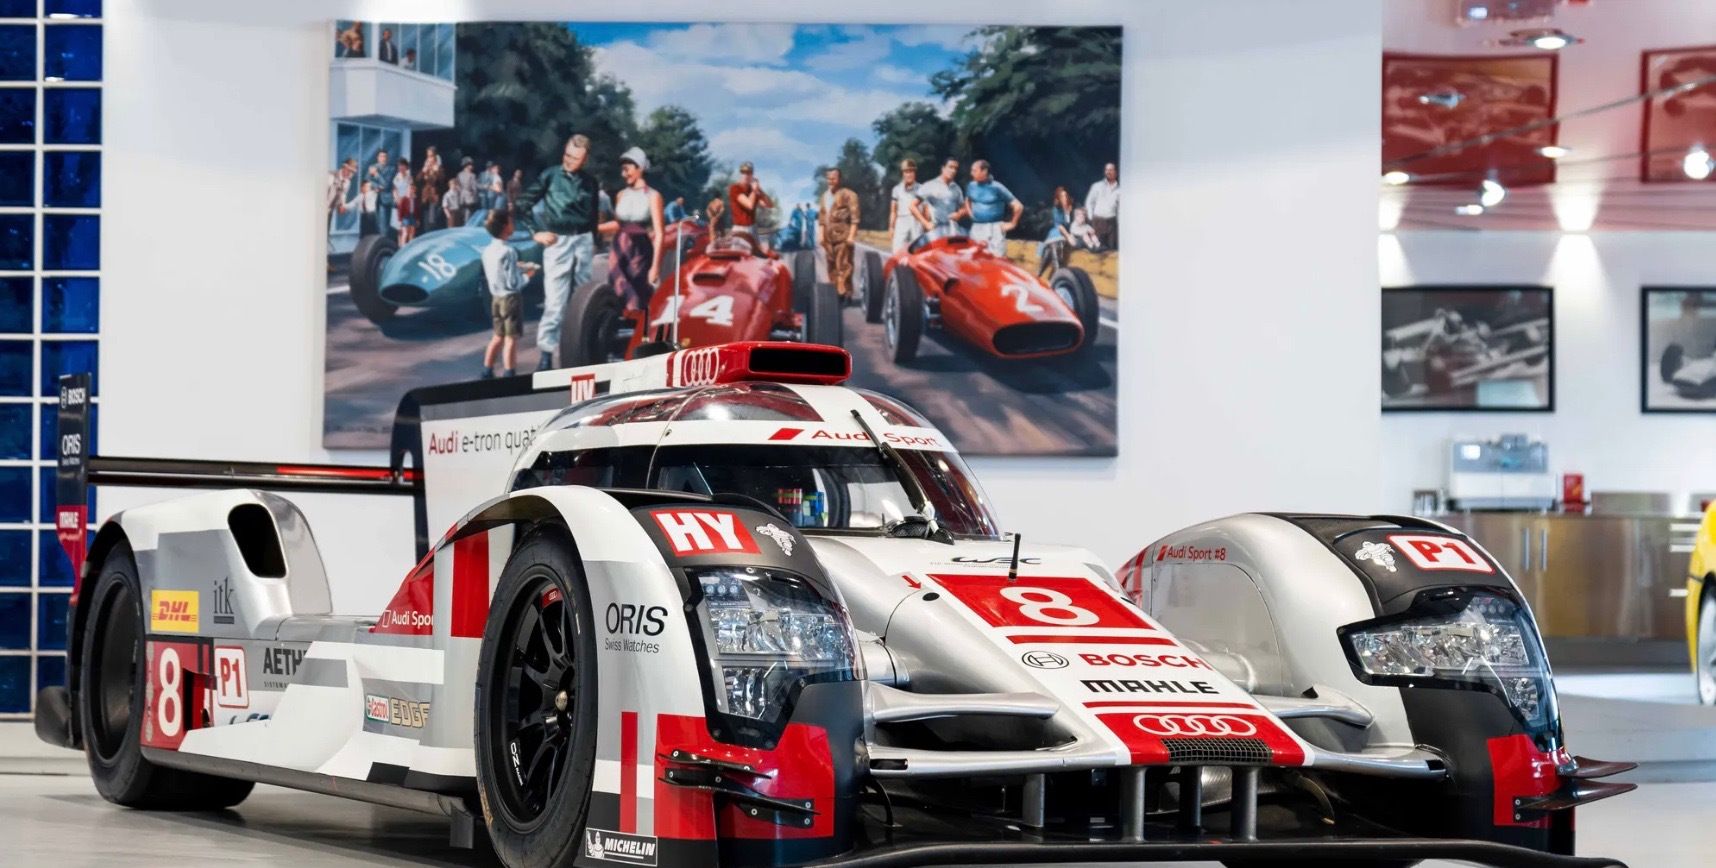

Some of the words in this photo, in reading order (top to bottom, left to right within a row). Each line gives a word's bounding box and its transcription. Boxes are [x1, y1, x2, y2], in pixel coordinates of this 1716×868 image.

[418, 253, 457, 280] 18
[1001, 283, 1044, 313] 2
[651, 295, 734, 327] 14
[68, 387, 86, 405] BOSCH
[62, 433, 81, 456] ORIS
[428, 431, 458, 455] Audi
[462, 432, 501, 452] e-tron
[505, 425, 537, 455] quat
[811, 430, 872, 441] Aud
[883, 432, 942, 447] Sport
[655, 512, 744, 552] HY
[1168, 545, 1187, 559] Audi
[1188, 546, 1212, 561] Sport
[1214, 547, 1226, 561] #8
[1407, 540, 1476, 564] P1
[213, 576, 234, 614] itk
[999, 586, 1098, 626] 8
[158, 600, 191, 621] DHL
[391, 611, 409, 625] Audi
[605, 602, 668, 636] ORIS
[605, 637, 622, 651] Swiss
[622, 639, 659, 653] Watches
[262, 647, 308, 676] AETH
[1078, 653, 1213, 671] BOSCH
[220, 657, 242, 698] P1
[1080, 680, 1219, 694] MAHLE
[158, 647, 182, 737] 8
[604, 838, 656, 856] MICHELIN
